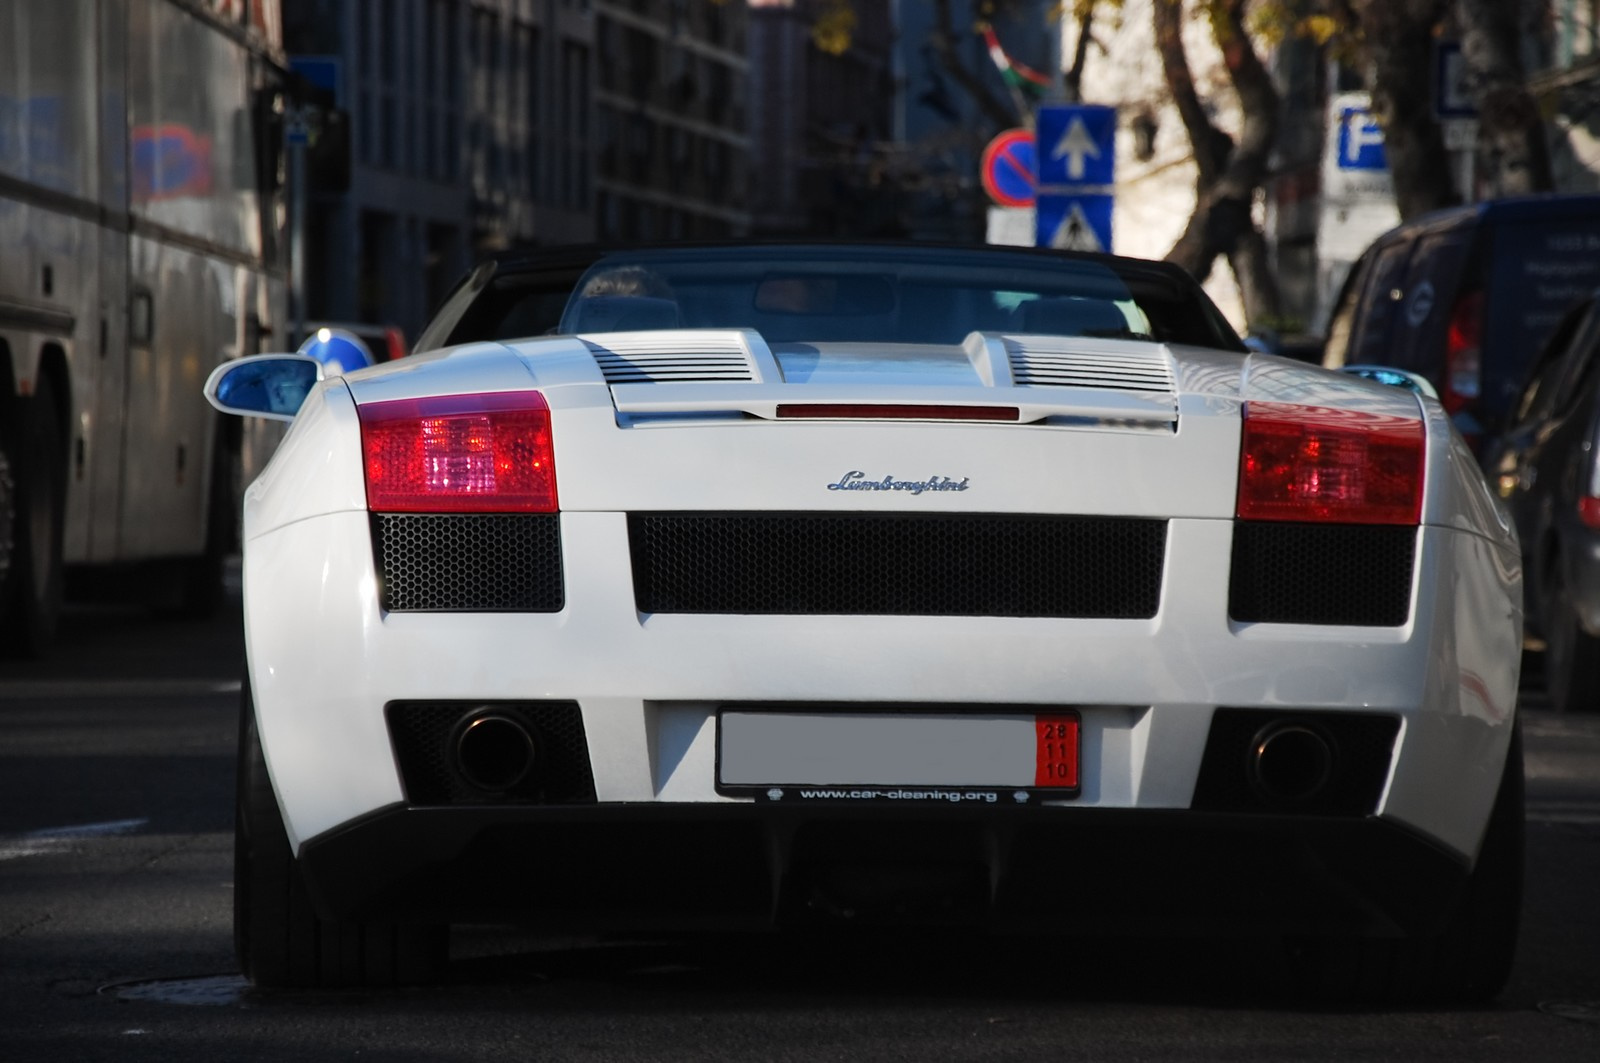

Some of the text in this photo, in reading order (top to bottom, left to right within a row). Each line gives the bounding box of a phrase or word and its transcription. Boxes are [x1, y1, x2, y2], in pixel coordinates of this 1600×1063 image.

[827, 470, 969, 496] Lamborghini
[1044, 723, 1067, 740] 28
[1046, 743, 1067, 759] 11
[1046, 763, 1069, 779] 10
[800, 788, 998, 803] www.car-cleaning.org
